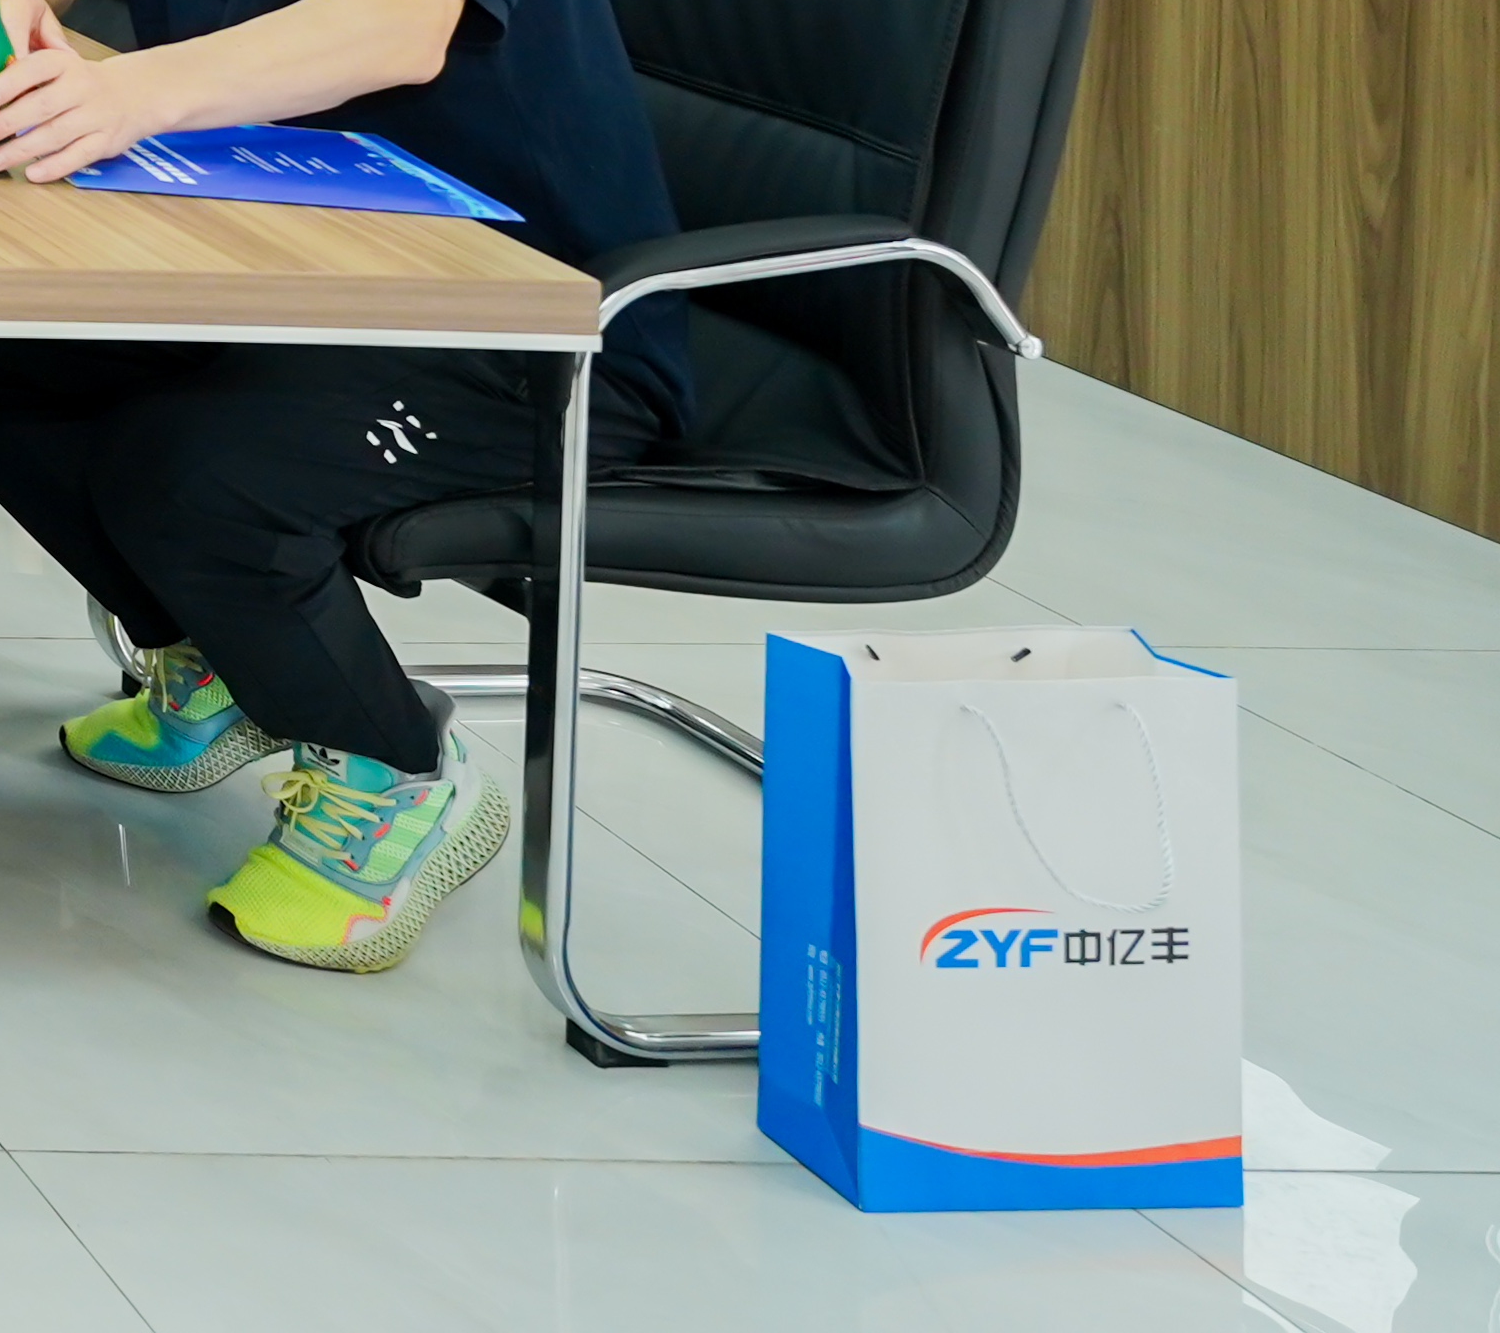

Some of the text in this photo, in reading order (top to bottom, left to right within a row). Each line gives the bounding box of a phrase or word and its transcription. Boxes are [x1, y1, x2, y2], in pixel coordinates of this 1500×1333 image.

[935, 926, 1190, 969] ZYF 中亿丰
